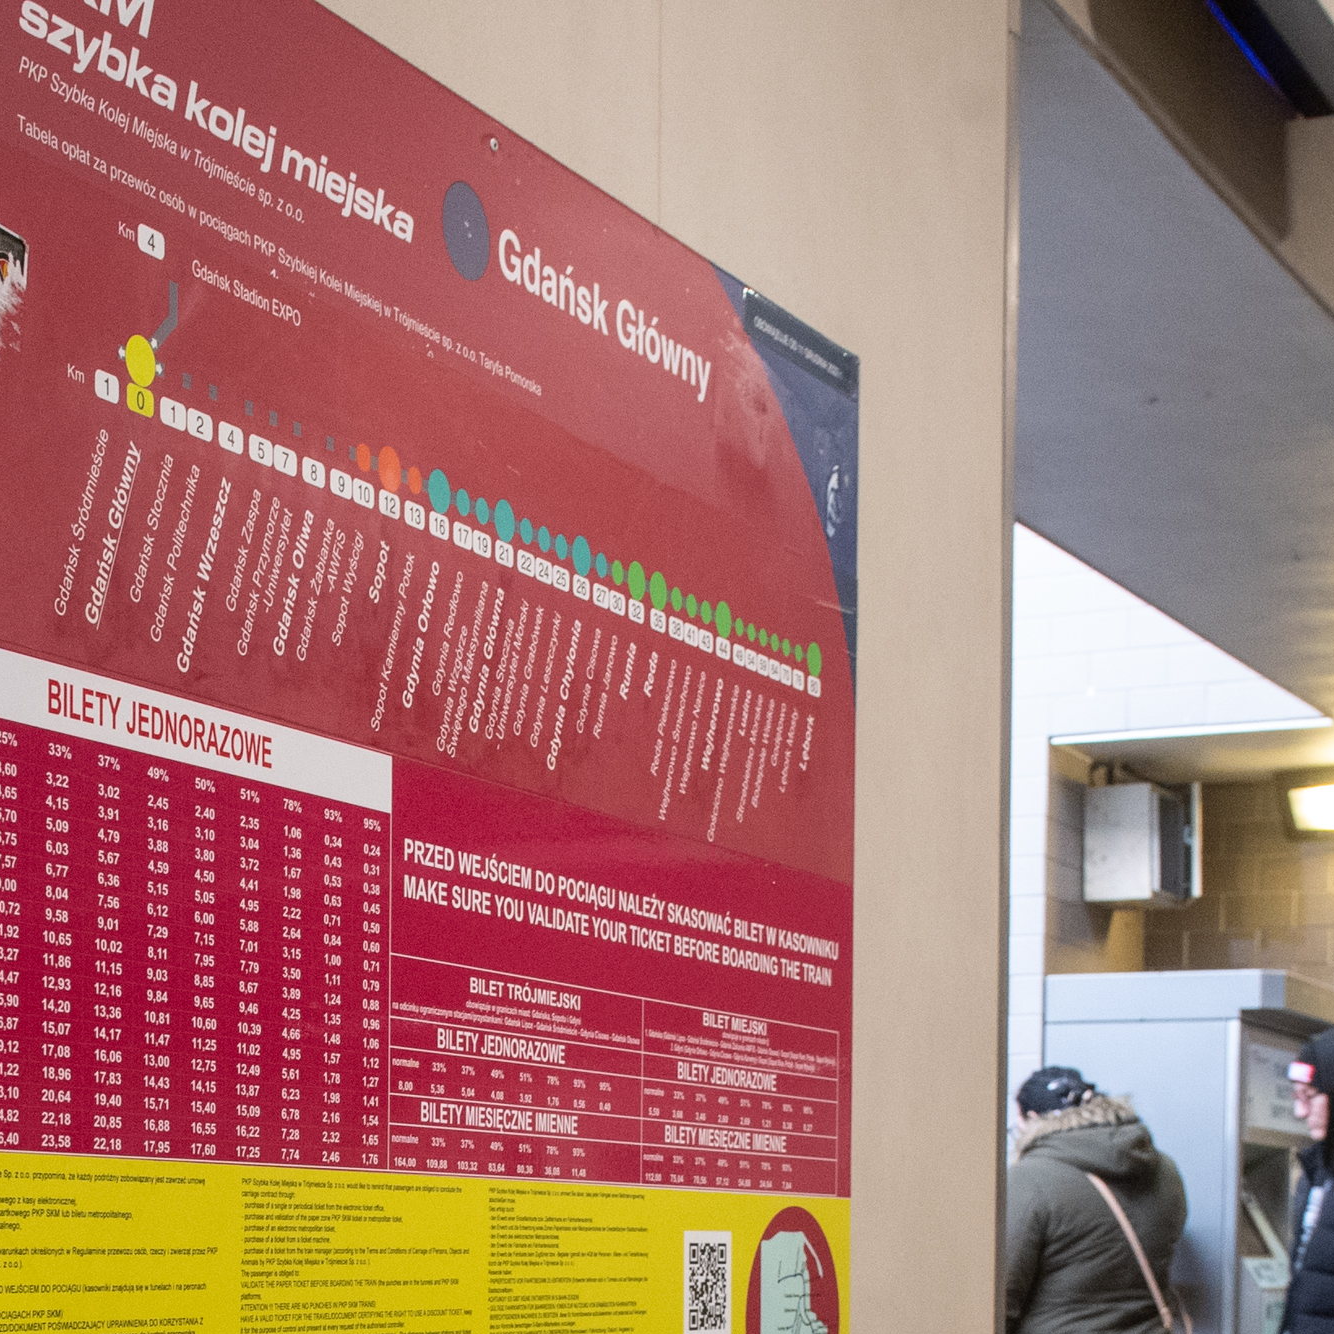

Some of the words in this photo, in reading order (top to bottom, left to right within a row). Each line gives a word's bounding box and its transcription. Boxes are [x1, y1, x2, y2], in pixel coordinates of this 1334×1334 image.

[17, 113, 58, 149] Tabela
[61, 141, 90, 165] opłat
[93, 156, 106, 174] za
[110, 165, 156, 198] przewóz
[159, 190, 185, 213] osób
[187, 204, 196, 218] w
[199, 210, 251, 246] pociągach
[18, 55, 47, 82] PKP
[50, 72, 94, 111] Szybka
[98, 98, 130, 133] Kolej
[131, 116, 177, 155] Miejska
[180, 146, 190, 160] w
[194, 148, 255, 196] Trójmieście
[257, 188, 273, 207] sp.
[276, 197, 283, 211] z
[285, 203, 304, 223] o.o.
[19, 0, 176, 110] szybka
[184, 80, 276, 172] kolej
[280, 145, 413, 242] miejska
[118, 220, 135, 242] Km
[147, 233, 155, 250] 4
[191, 259, 230, 292] Gdańsk
[233, 279, 269, 311] Stadion
[272, 298, 300, 326] EXPO
[67, 364, 84, 383] Km
[498, 228, 608, 335] Gdańsk
[616, 299, 710, 402] Główny
[54, 544, 80, 615] Gdańsk
[70, 429, 108, 540] Śródmieście
[84, 533, 116, 623] Gdańsk
[107, 440, 141, 529] Główny
[129, 533, 154, 602] Gdańsk
[146, 454, 173, 530] Stocznia
[150, 573, 174, 642] Gdańsk
[166, 464, 200, 570] Politechnika
[176, 586, 205, 672] Gdańsk
[196, 476, 231, 581] Wrzeszcz
[272, 573, 299, 655] Gdańsk
[292, 509, 314, 568] Oliwa
[368, 540, 389, 603] Sopot
[370, 682, 387, 731] Sopot
[381, 600, 405, 680] Kamienny
[398, 552, 414, 598] Potok
[402, 637, 424, 708] Gdynia
[417, 561, 439, 632] Orłowo
[432, 641, 449, 695] Gdynia
[443, 570, 463, 638] Redłowo
[468, 664, 489, 733] Gdynia
[483, 587, 504, 659] Główna
[619, 642, 636, 699] Rumia
[48, 678, 120, 729] BILETY
[126, 701, 271, 768] JEDNORAZOWE
[48, 742, 71, 759] 33%
[97, 754, 120, 770] 37%
[45, 771, 68, 788] 3,22
[98, 783, 119, 799] 3,02
[147, 794, 168, 809] 2,45
[403, 874, 447, 905] MAKE
[451, 885, 490, 914] SURE
[494, 894, 523, 921] YOU
[527, 902, 588, 935] VALIDATE
[591, 916, 626, 943] YOUR
[629, 924, 671, 952] TICKET
[674, 934, 719, 963] BEFORE
[722, 945, 778, 975] BOARDING
[780, 958, 800, 980] THE
[802, 963, 831, 986] TRAIN
[404, 838, 454, 871] PRZED
[458, 851, 531, 889] WEJŚCIEM
[535, 870, 554, 894] DO
[558, 875, 615, 910] POCIĄGU
[618, 890, 665, 919] NALEŻY
[667, 902, 731, 935] SKASOWAĆ
[734, 918, 764, 942] BILET
[765, 926, 776, 945] W
[778, 929, 838, 960] KASOWNIKU
[437, 1027, 478, 1052] BILETY
[480, 1034, 567, 1064] JEDNORAZOWE
[469, 976, 504, 997] BILET
[506, 983, 580, 1010] TRÓJMIEJSKI
[420, 1101, 462, 1124] BILETY
[465, 1105, 532, 1131] MIESIĘCZNE
[535, 1112, 577, 1134] IMIENNE
